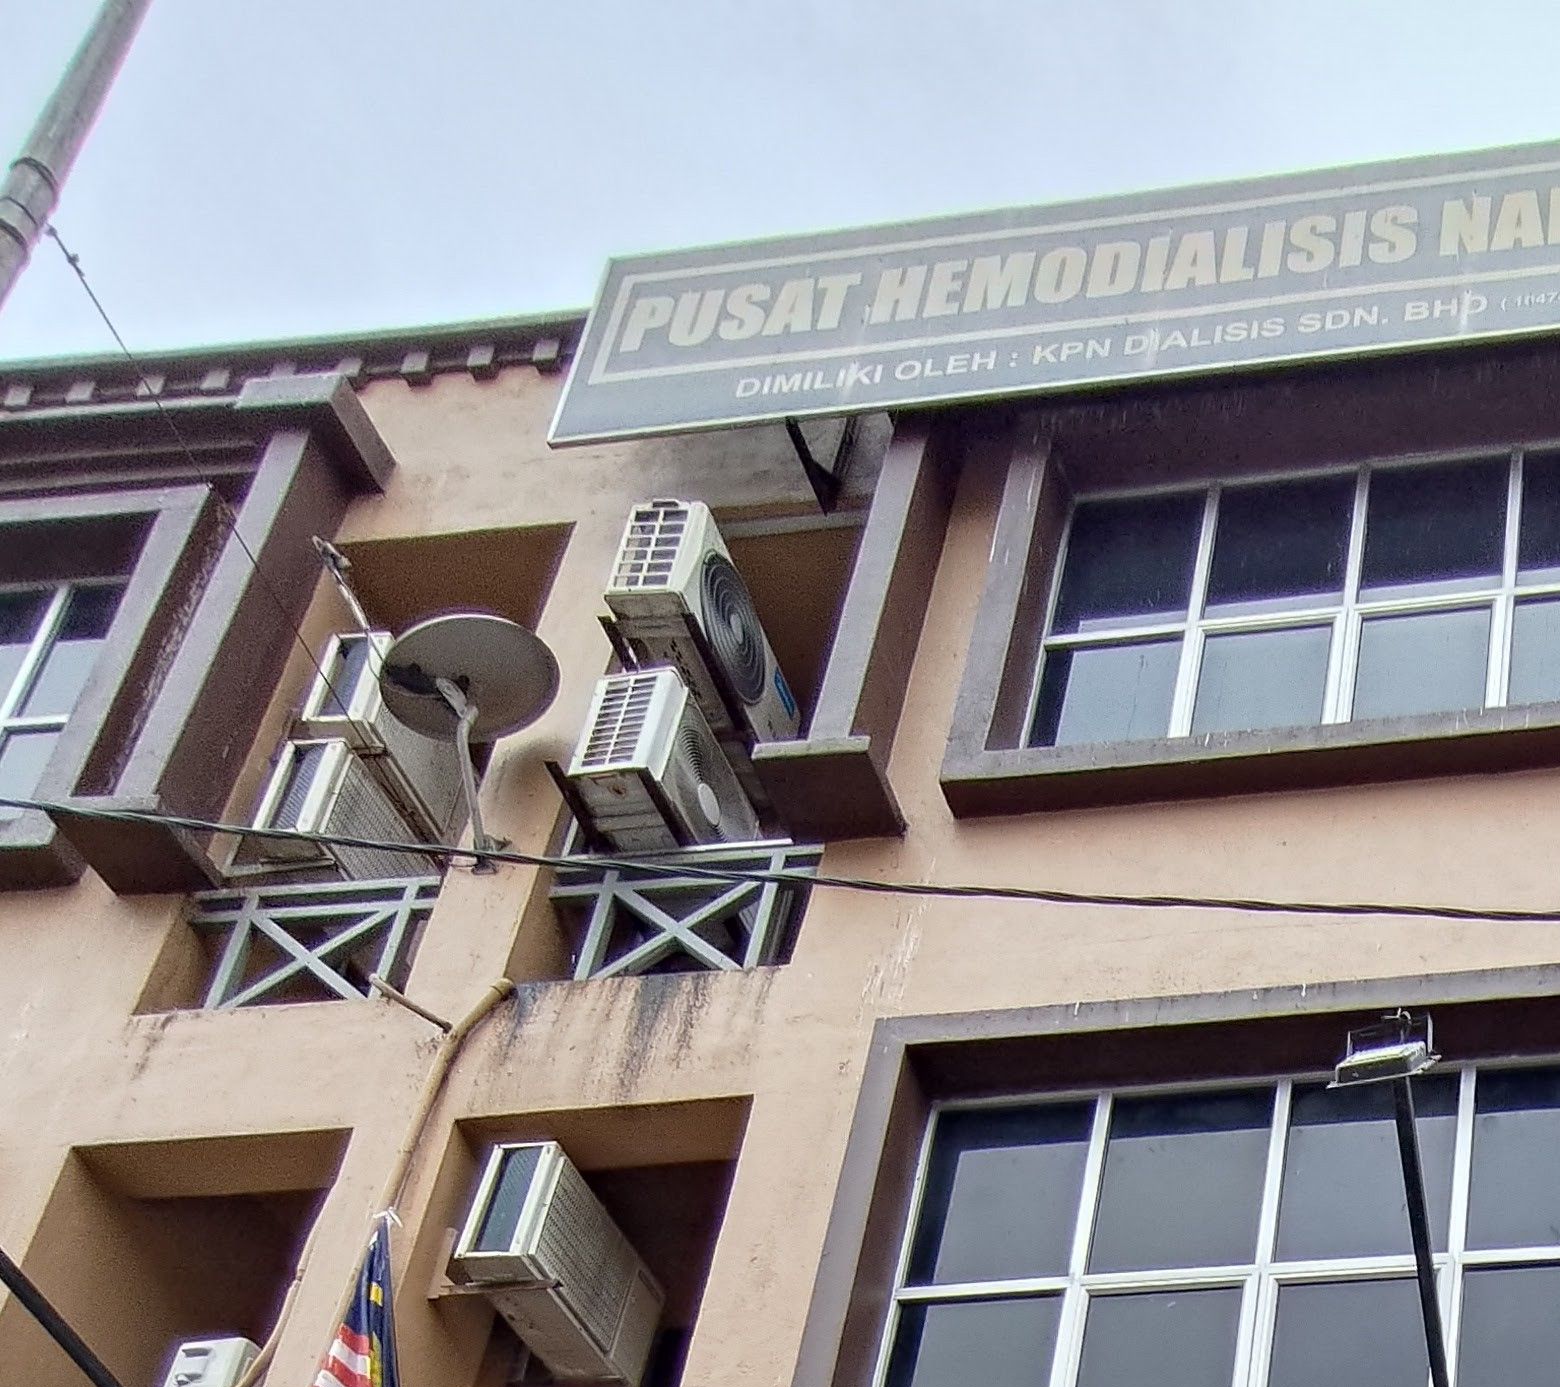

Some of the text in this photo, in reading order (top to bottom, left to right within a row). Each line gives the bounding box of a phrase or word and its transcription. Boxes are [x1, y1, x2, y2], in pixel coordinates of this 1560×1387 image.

[618, 272, 865, 353] PUSAT
[866, 205, 1417, 326] HEMODIALISIS
[735, 362, 883, 399] DIMILIKI
[894, 349, 996, 383] OLEH
[1032, 337, 1111, 366] KPN
[1122, 314, 1287, 357] DIALISIS
[1404, 294, 1489, 325] BHD
